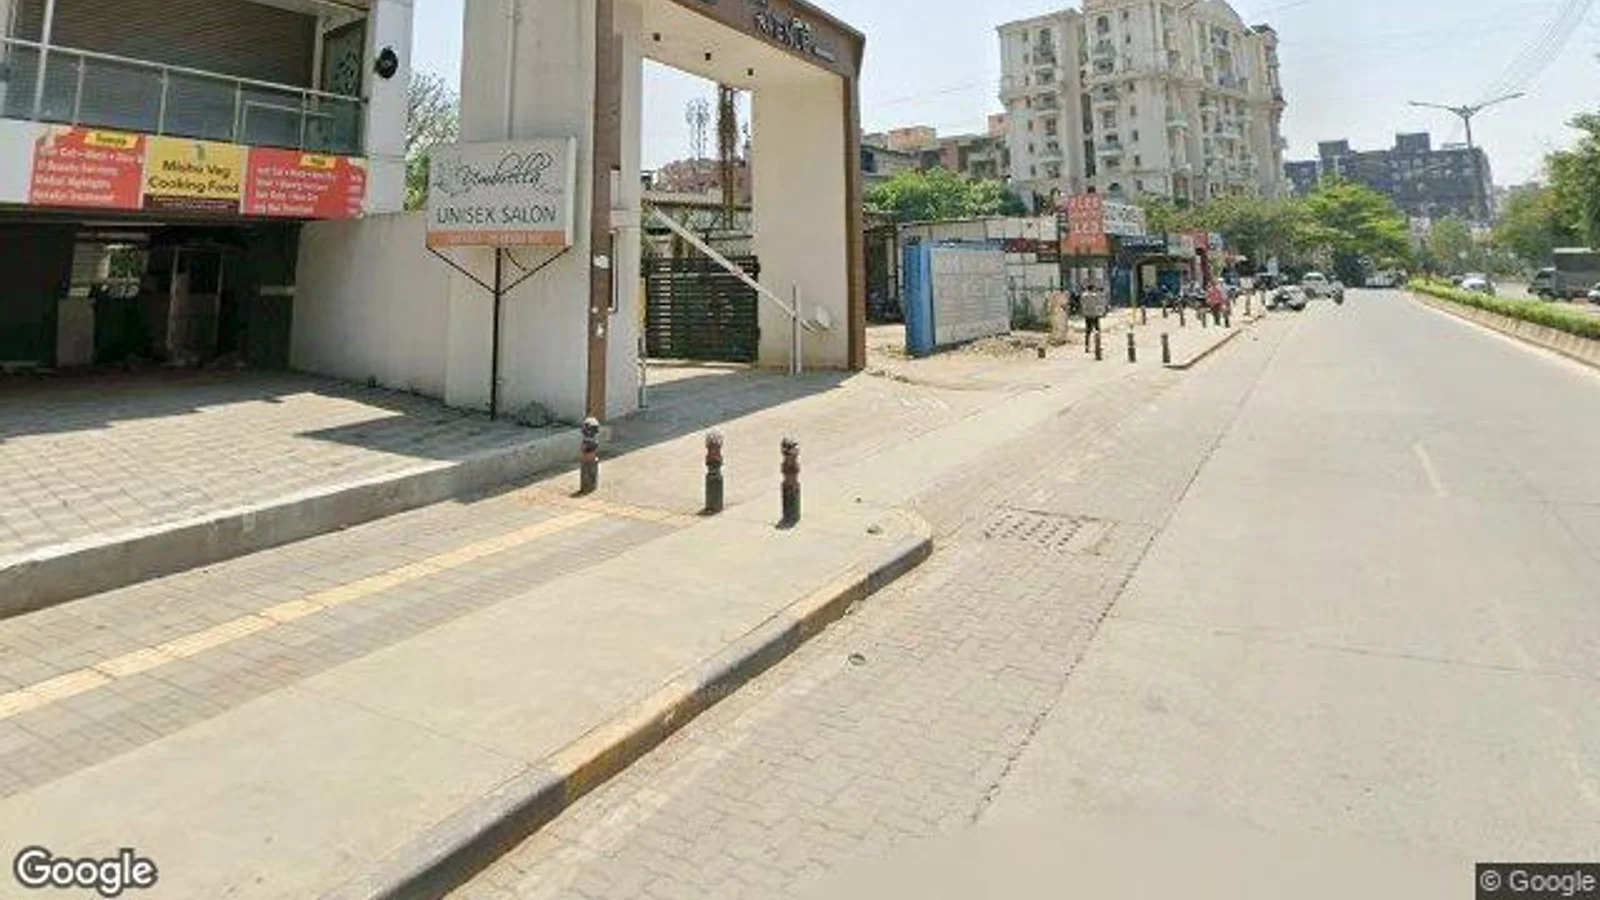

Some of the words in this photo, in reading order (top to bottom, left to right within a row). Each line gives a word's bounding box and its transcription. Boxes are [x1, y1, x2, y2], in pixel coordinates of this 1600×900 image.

[148, 175, 206, 194] Cooking
[436, 206, 497, 225] UNISEX
[501, 204, 557, 224] SALON
